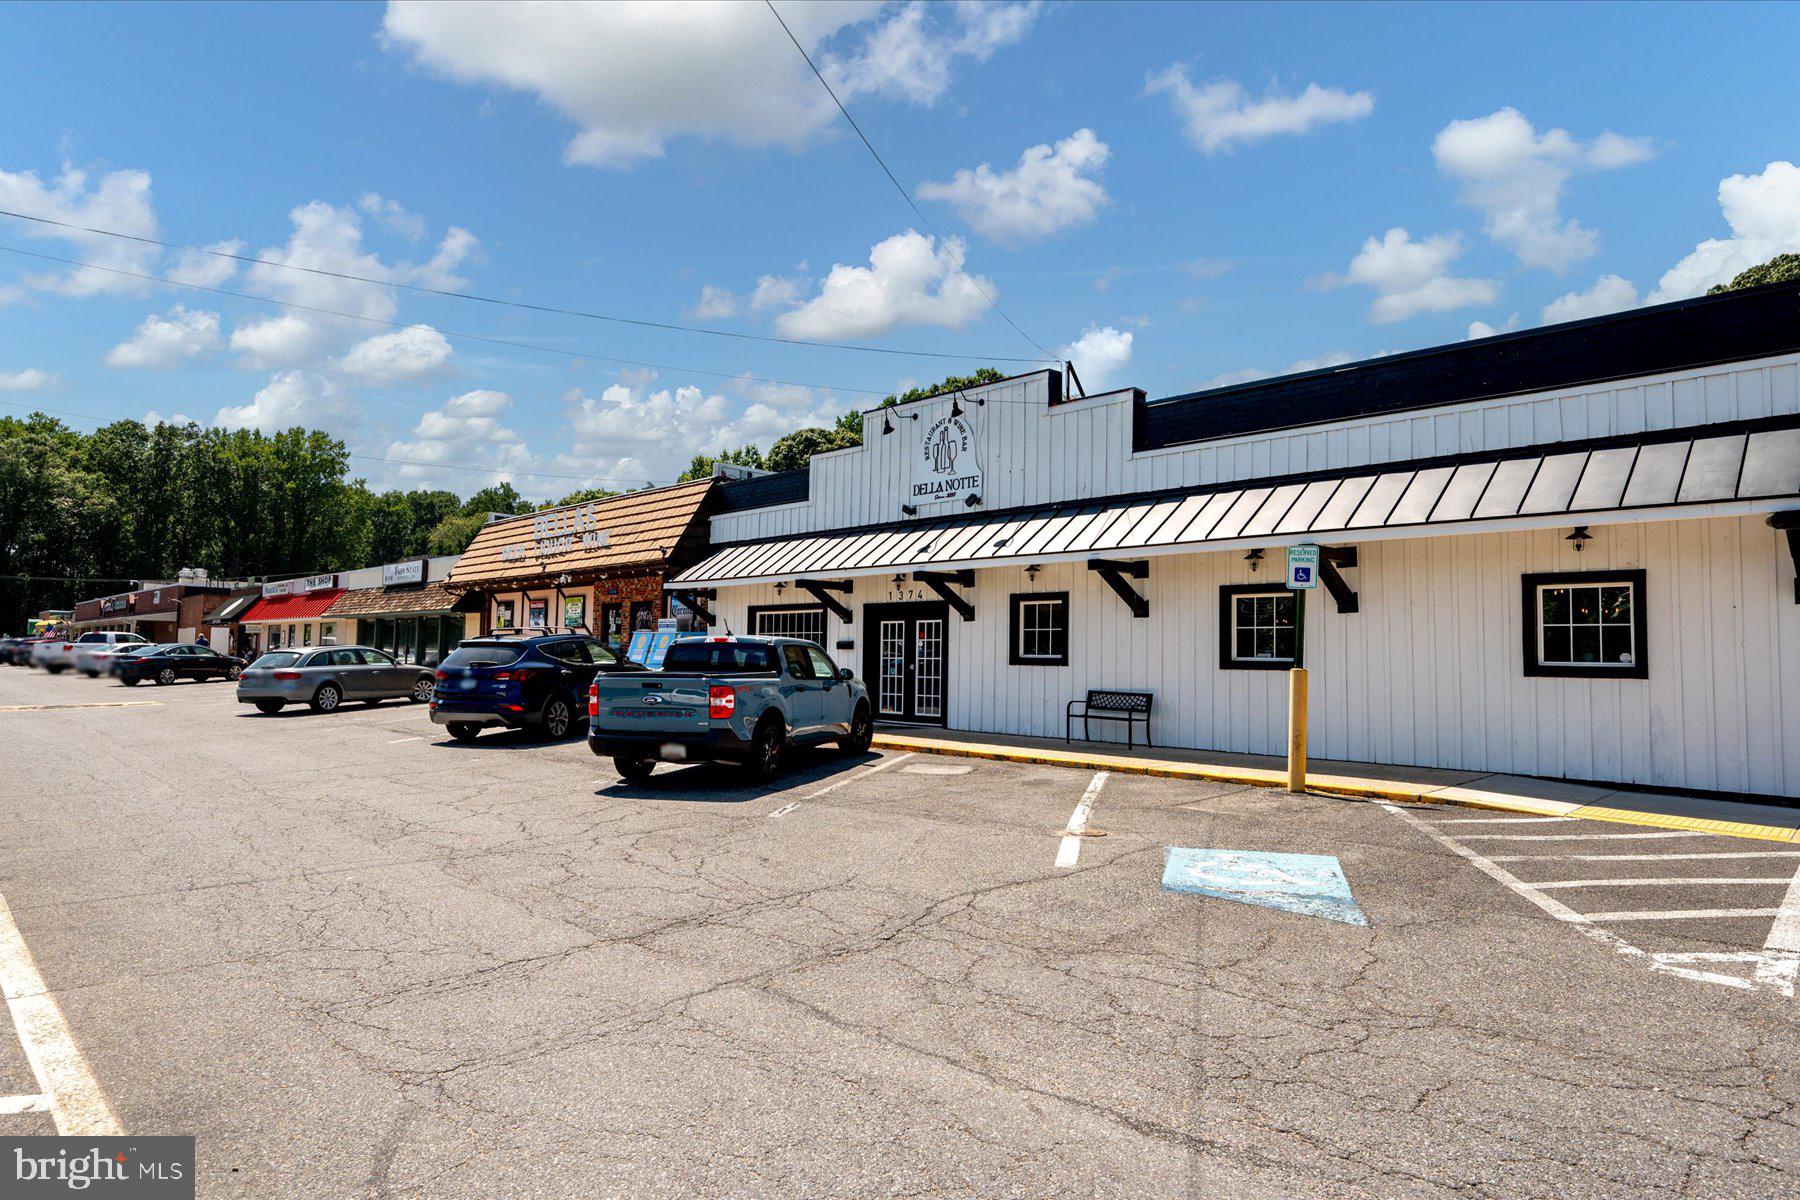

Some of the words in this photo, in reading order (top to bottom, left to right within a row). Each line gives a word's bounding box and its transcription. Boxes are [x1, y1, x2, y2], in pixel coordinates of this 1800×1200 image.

[924, 418, 946, 461] RESTAURANT
[953, 418, 967, 436] WINE
[913, 481, 944, 497] DELLA
[945, 475, 980, 491] NOTTE
[306, 580, 316, 589] THE
[318, 576, 332, 585] SHOP
[888, 590, 923, 600] 1374
